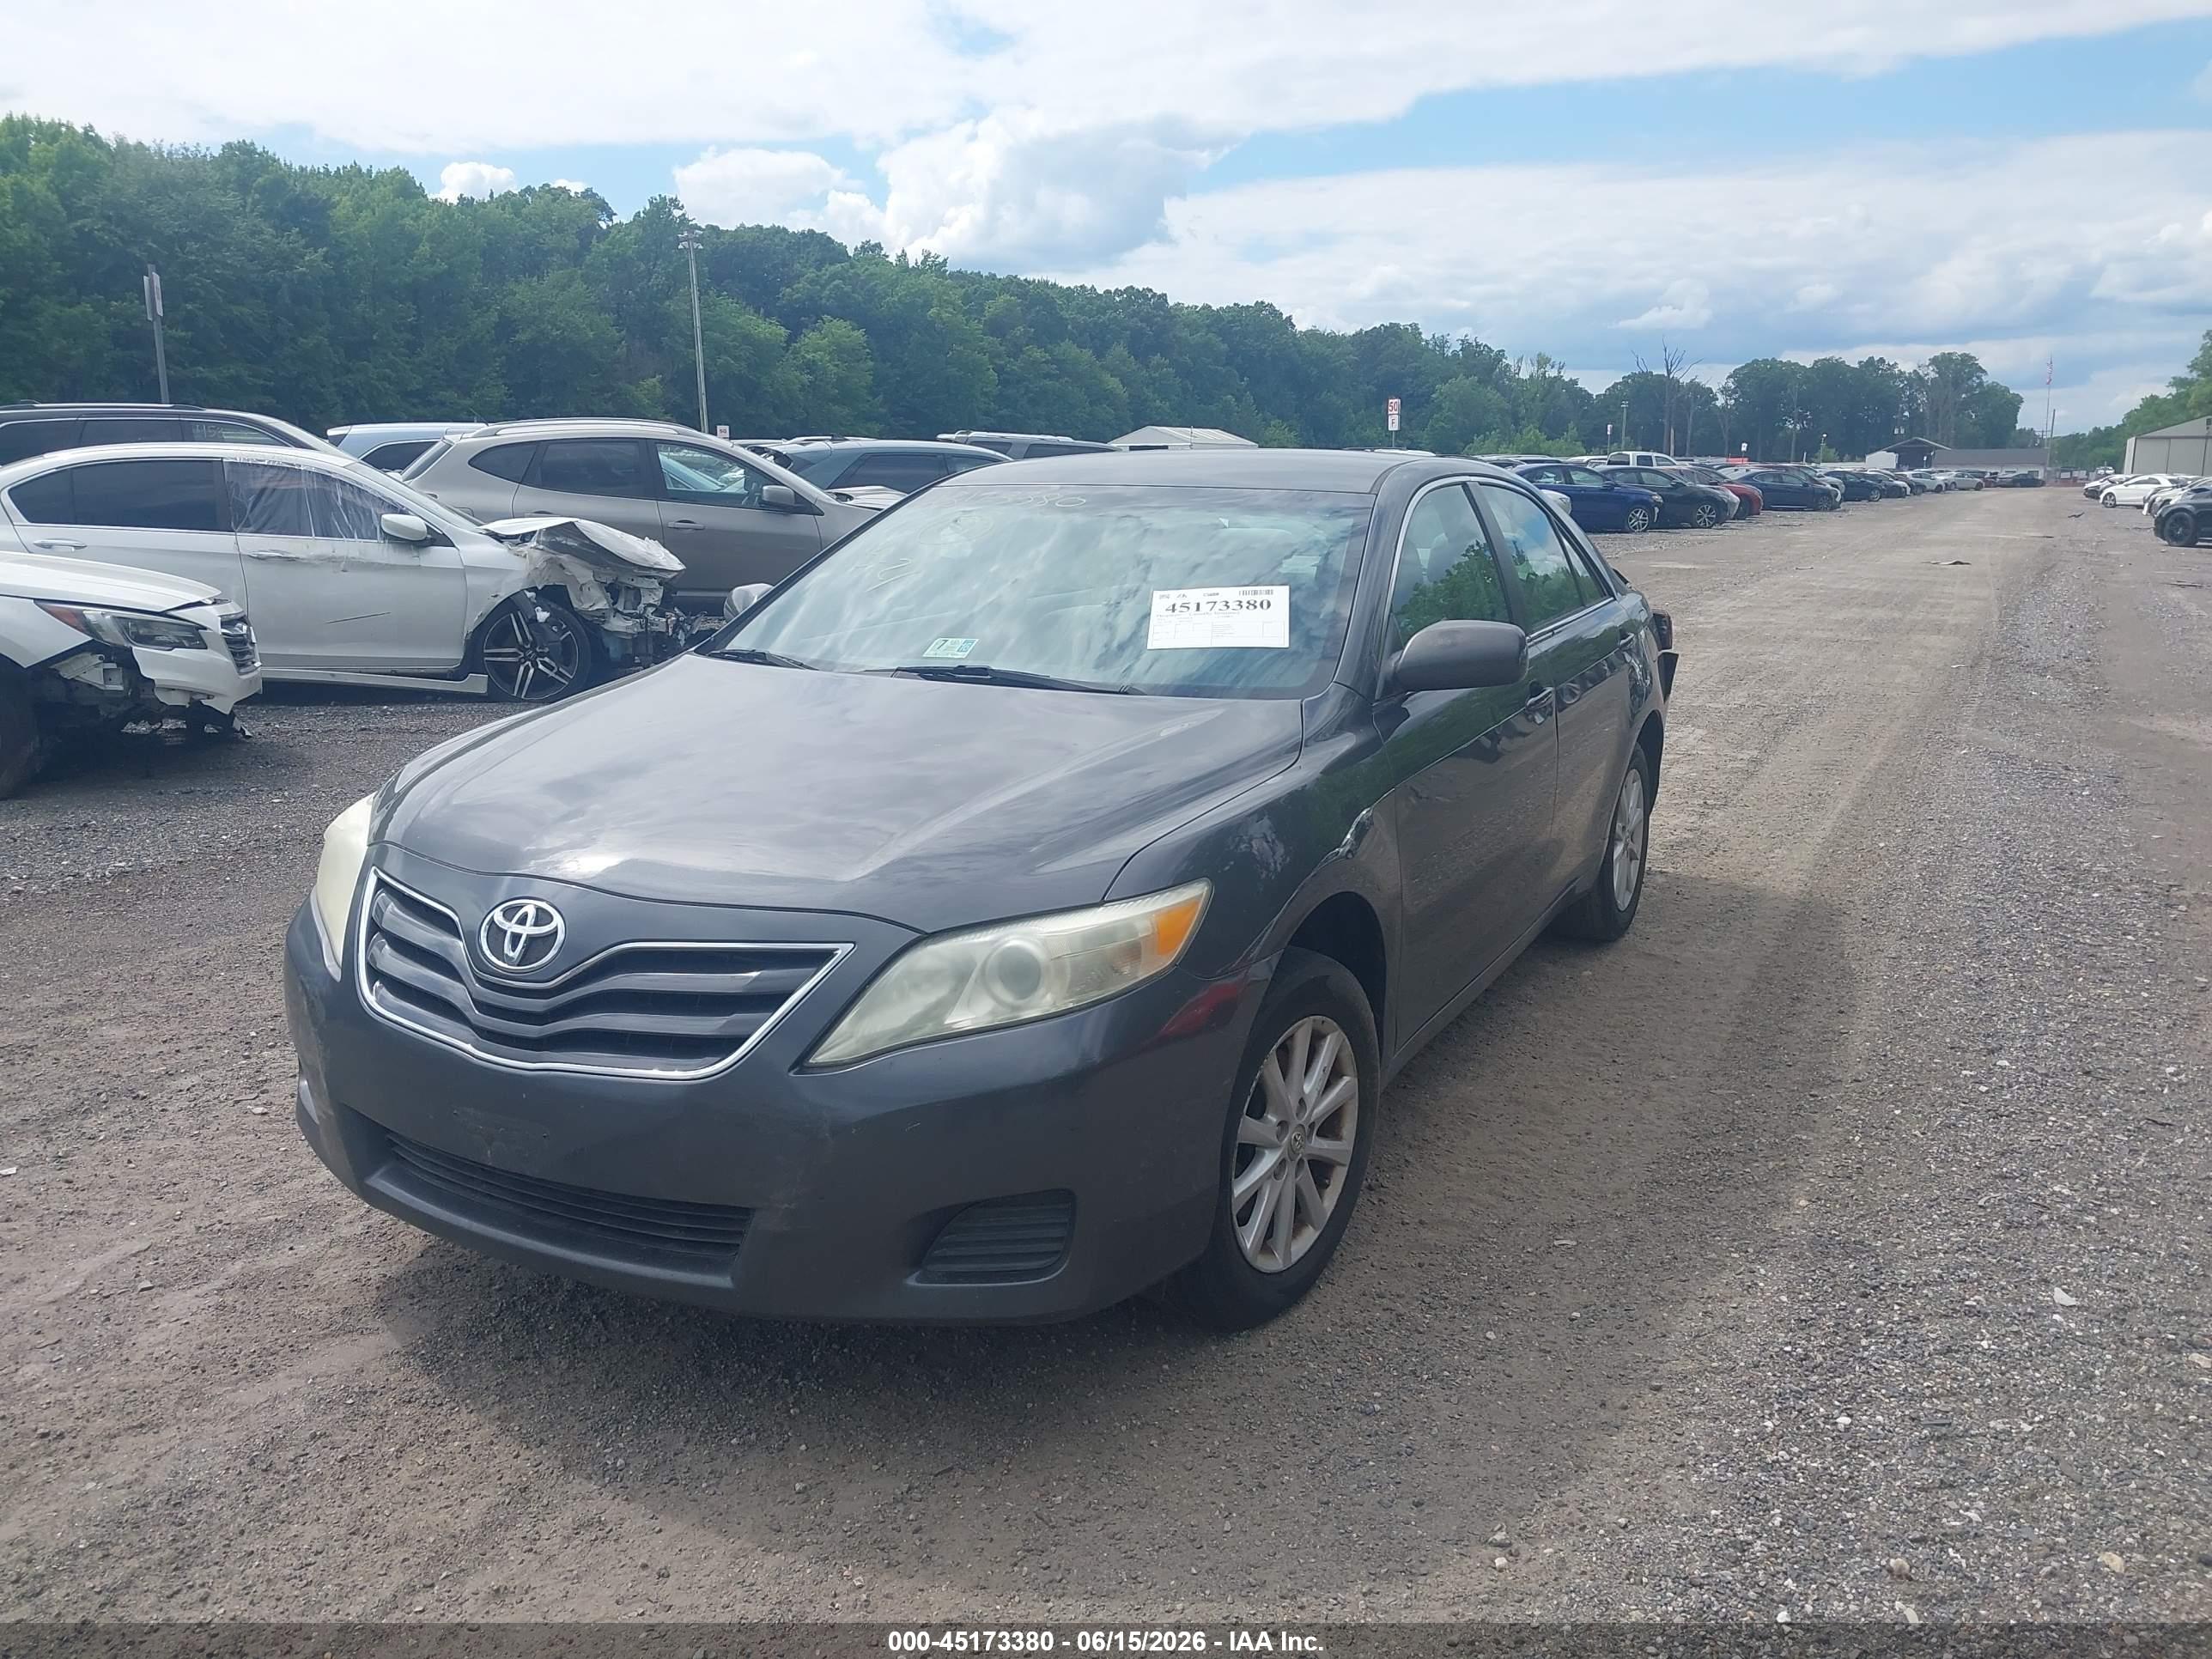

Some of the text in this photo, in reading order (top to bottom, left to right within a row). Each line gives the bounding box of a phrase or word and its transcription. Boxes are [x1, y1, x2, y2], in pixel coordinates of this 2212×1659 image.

[1389, 401, 1398, 412] 50
[1391, 418, 1395, 428] F
[1165, 599, 1272, 613] 45173380
[936, 639, 949, 650] 7
